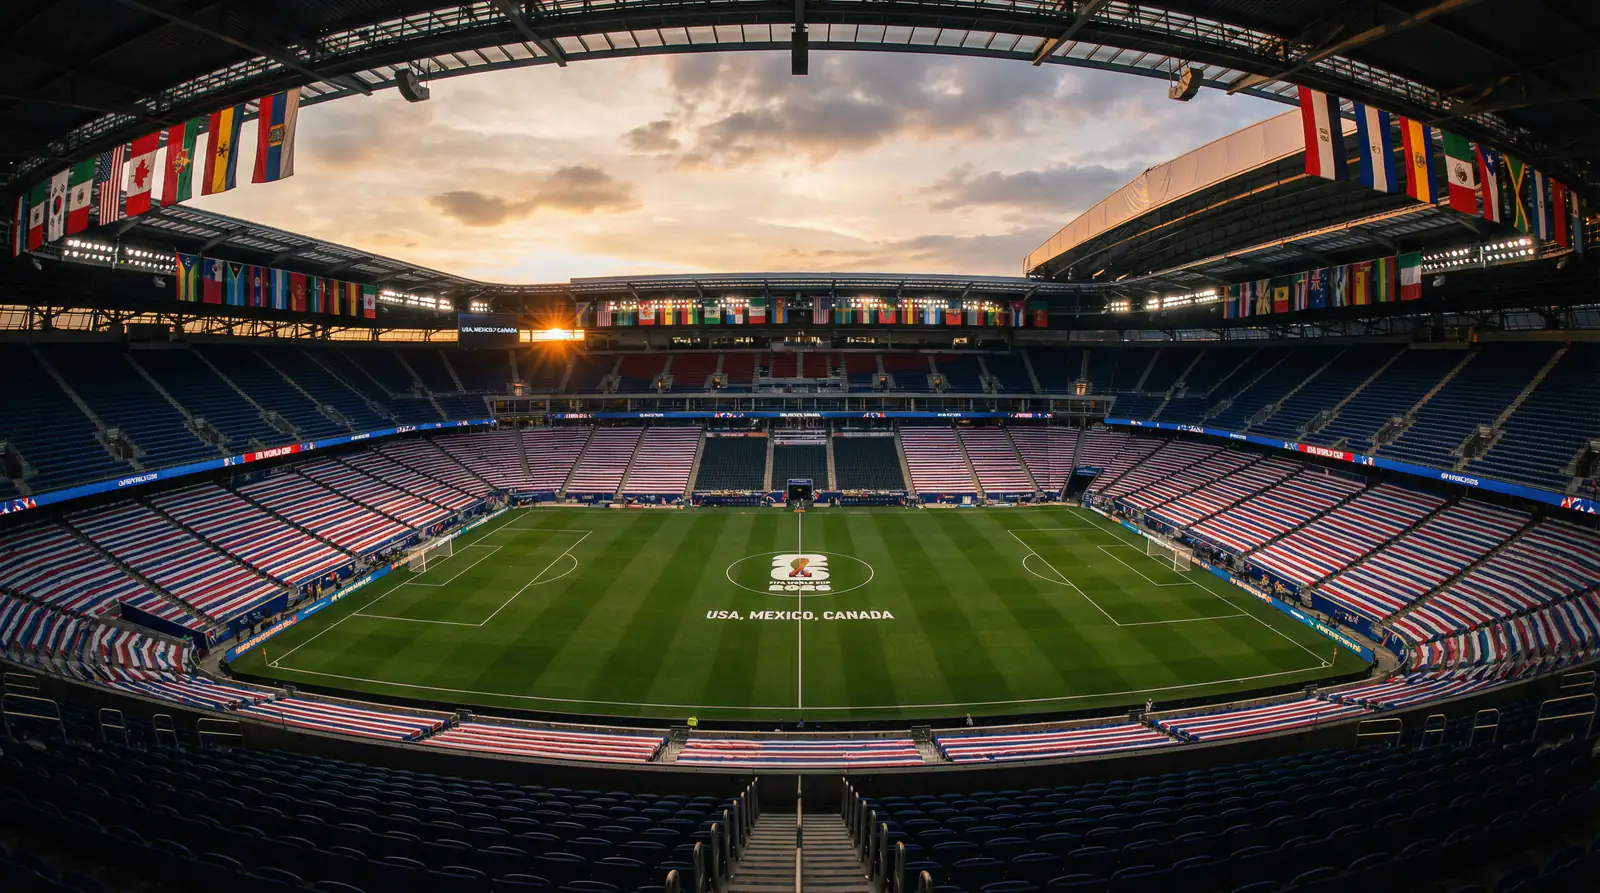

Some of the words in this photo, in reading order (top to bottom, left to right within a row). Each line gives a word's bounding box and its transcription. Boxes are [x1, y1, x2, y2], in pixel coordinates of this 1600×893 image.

[706, 610, 745, 621] USA,
[749, 610, 819, 621] MEXICO,
[822, 610, 895, 620] CANADA
